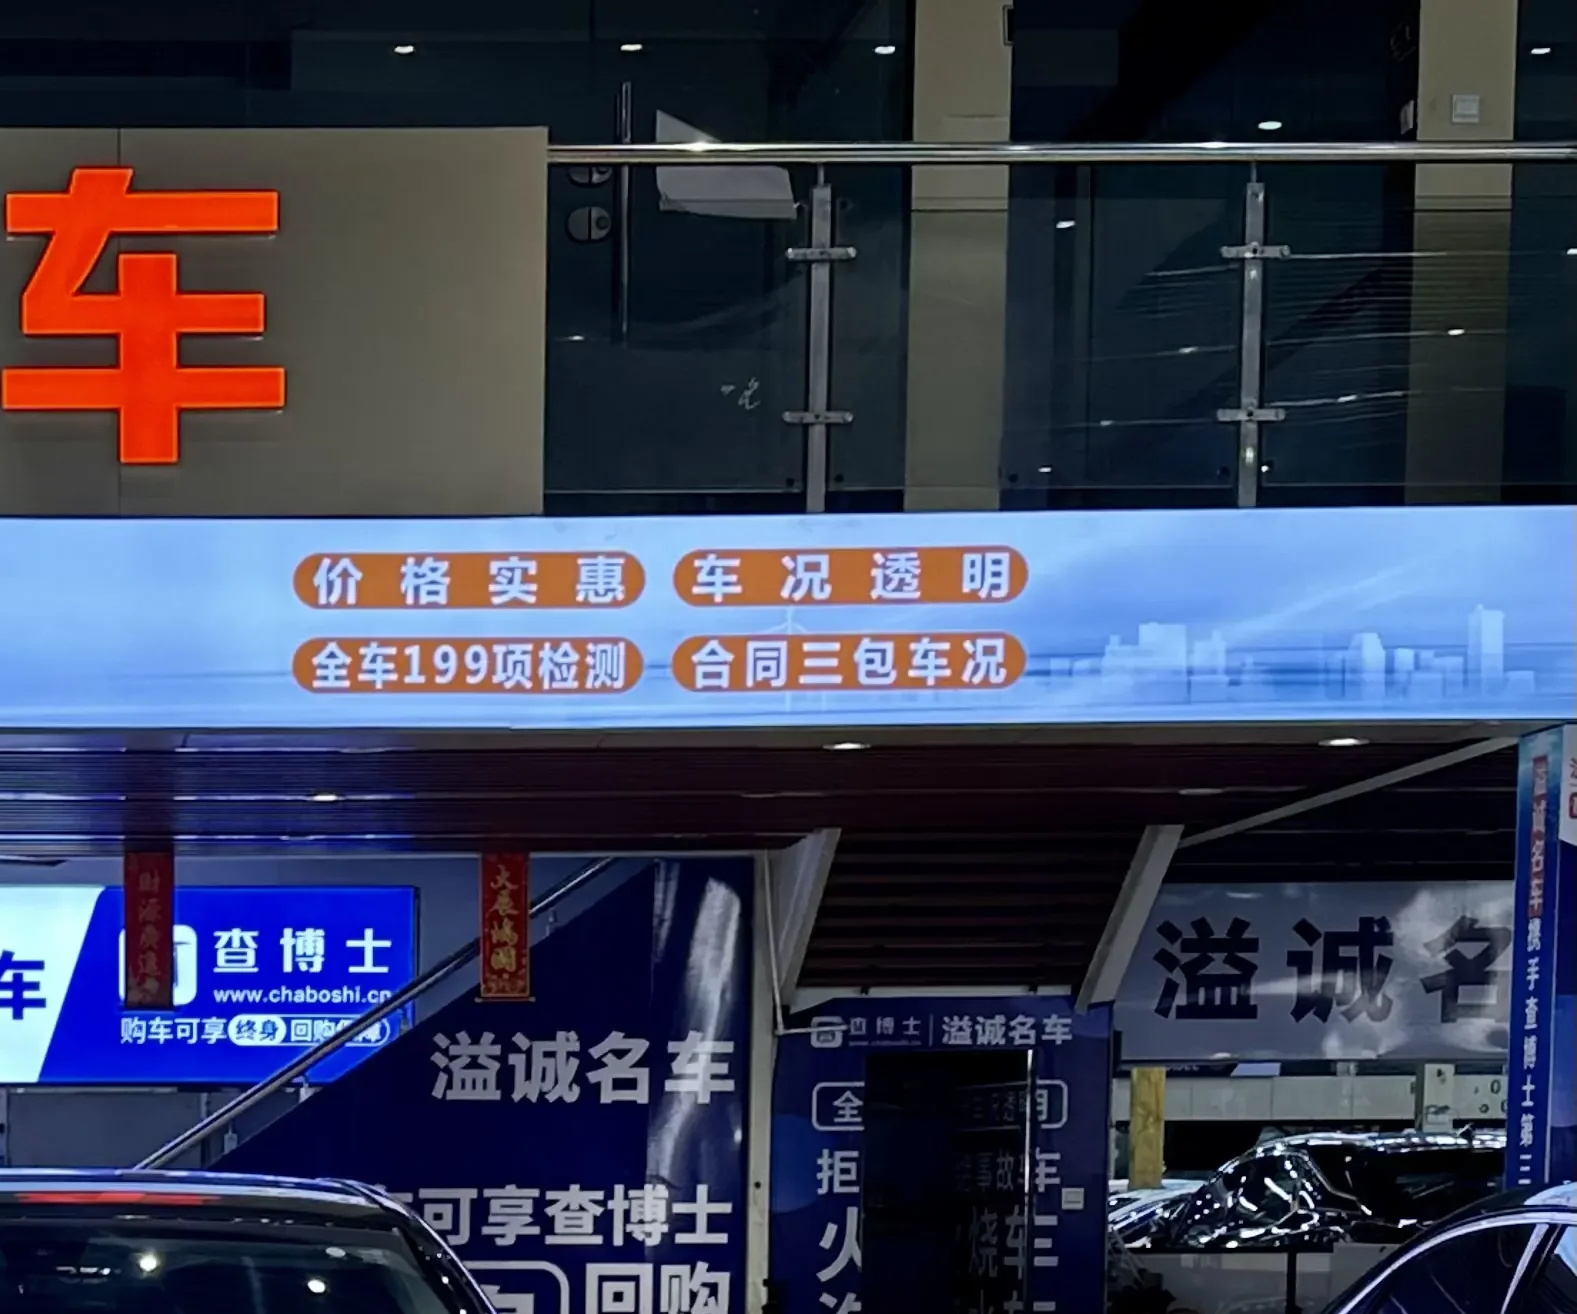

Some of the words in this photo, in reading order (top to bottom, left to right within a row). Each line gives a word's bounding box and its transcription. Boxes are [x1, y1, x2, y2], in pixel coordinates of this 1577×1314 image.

[313, 556, 628, 606] 价格实惠
[691, 552, 1010, 602] 车况透明
[311, 640, 627, 690] 全车199项检测
[690, 637, 1007, 689] 合同三包车况
[212, 927, 392, 974] 查博士
[1153, 916, 1512, 1024] 溢诚名
[120, 1016, 227, 1045] 购车可享
[941, 1013, 1073, 1047] 溢诚名车
[429, 1029, 736, 1105] 溢诚名车
[375, 1184, 733, 1247] 可享查博士
